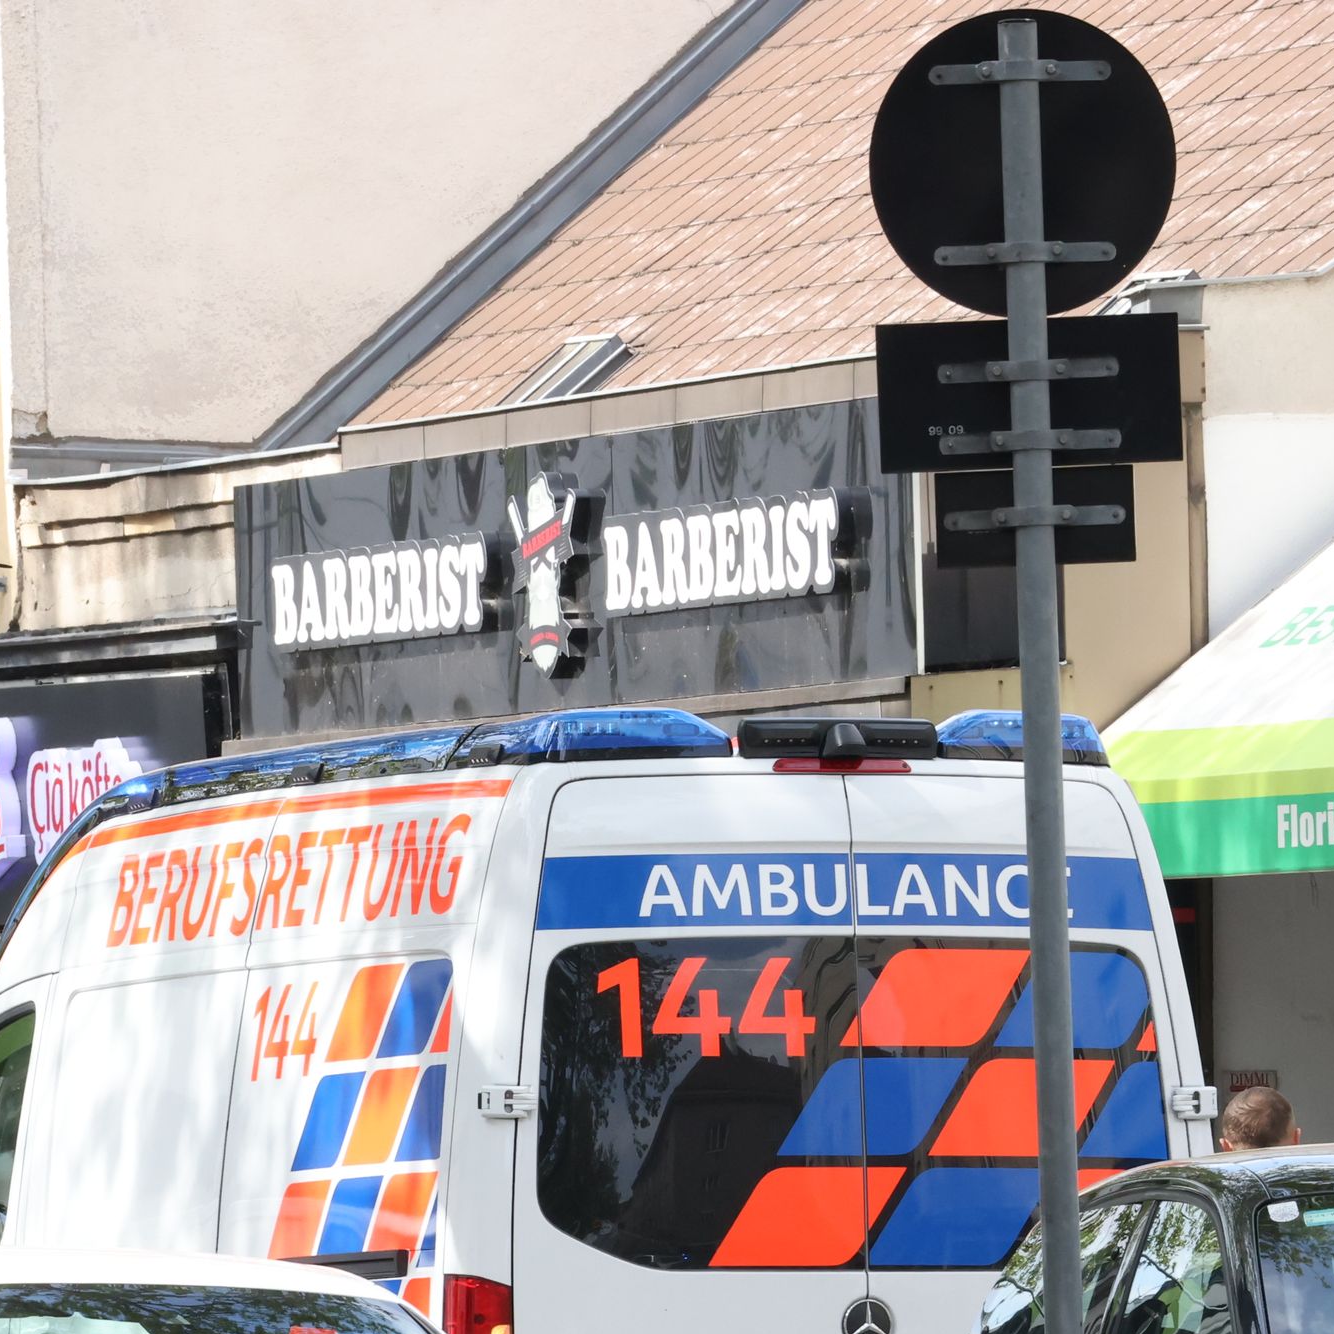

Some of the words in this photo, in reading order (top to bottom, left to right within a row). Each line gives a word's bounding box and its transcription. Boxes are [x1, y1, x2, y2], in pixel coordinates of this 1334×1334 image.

[271, 541, 486, 645] BARBERIST
[603, 496, 836, 611] BARBERIST
[106, 813, 472, 948] BERUFSRETTUNG
[639, 863, 1074, 920] AMBULANC
[250, 981, 319, 1082] 144
[597, 956, 817, 1058] 144
